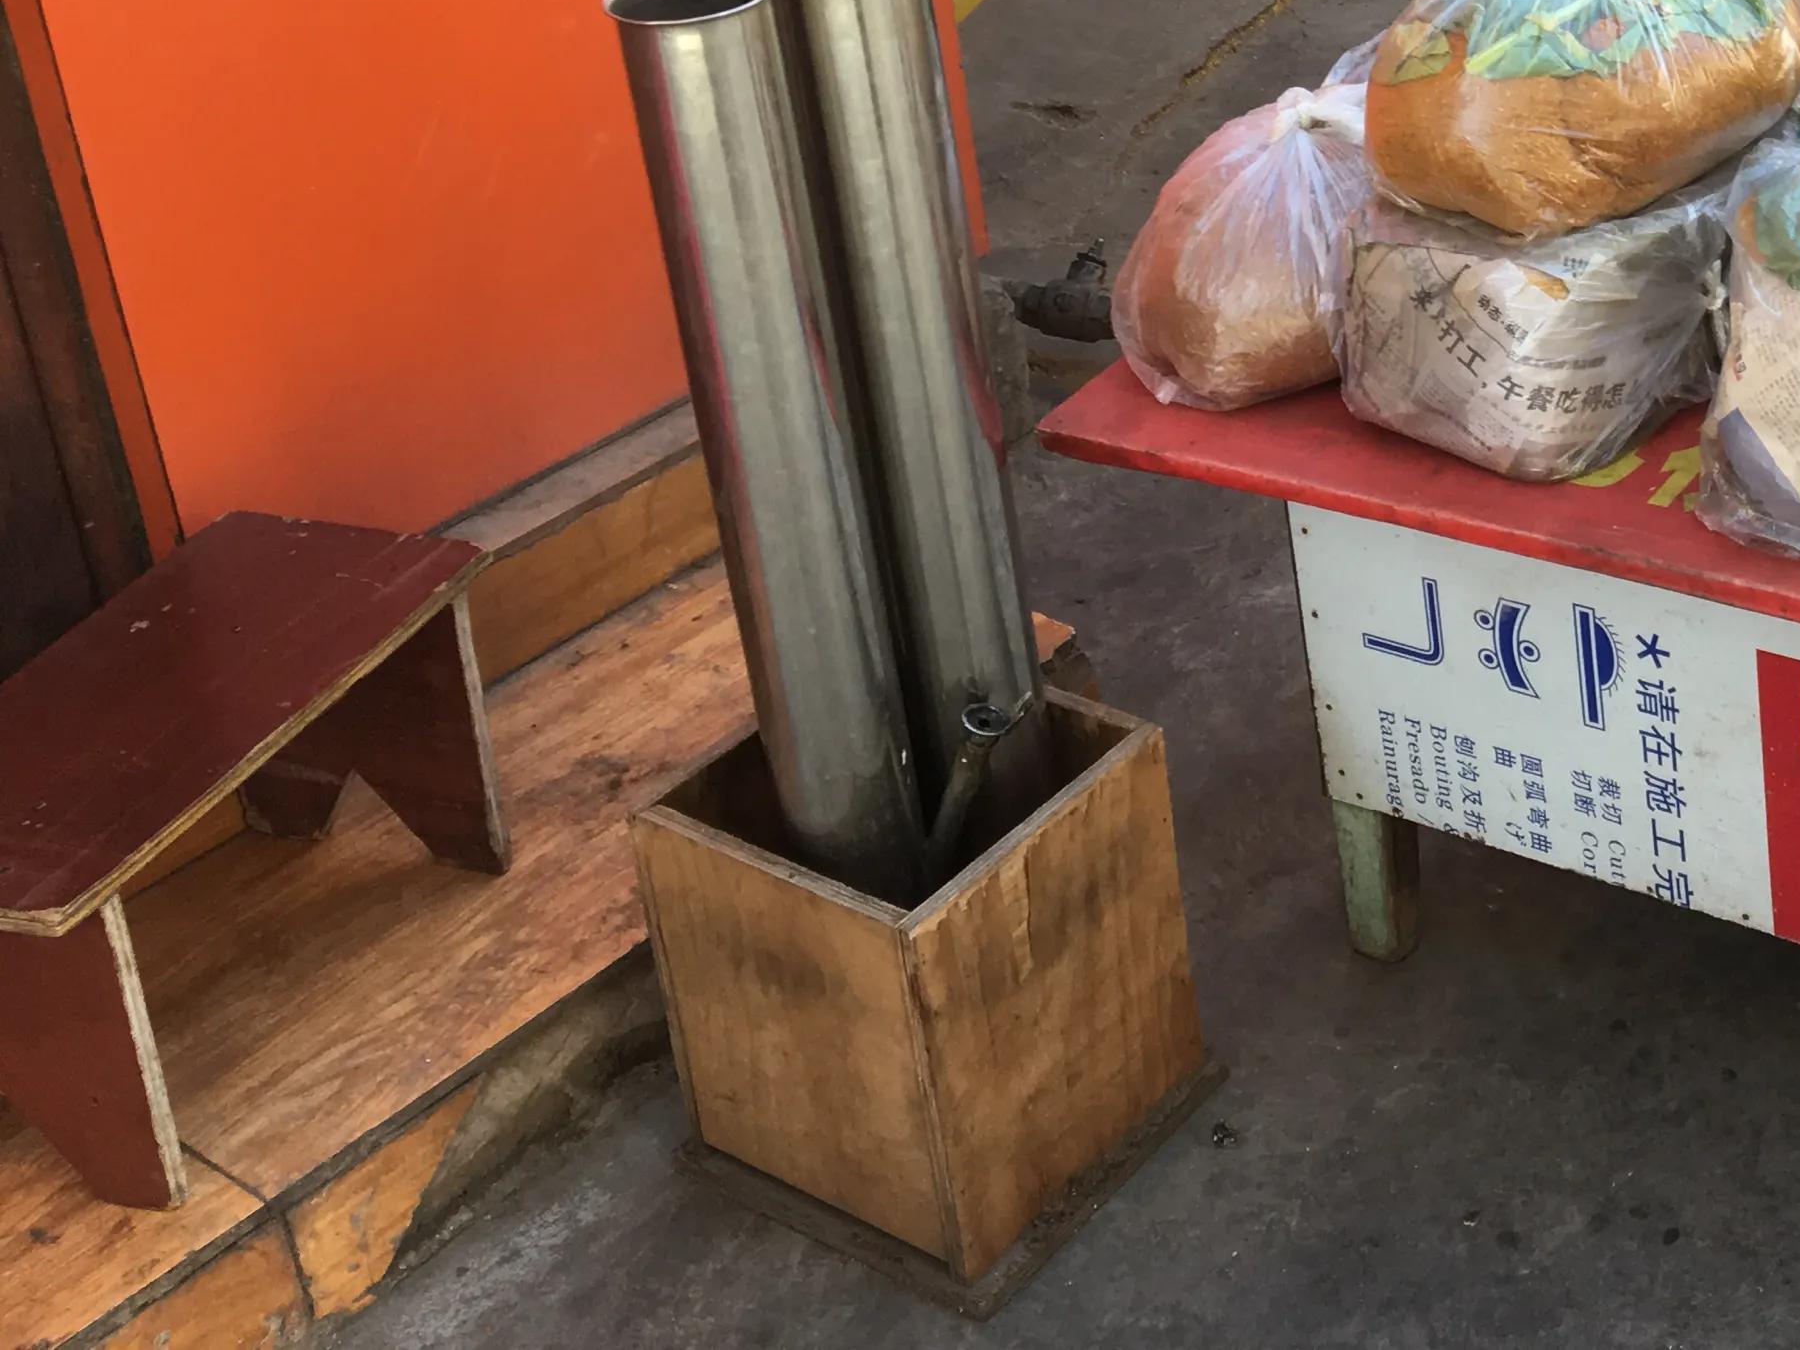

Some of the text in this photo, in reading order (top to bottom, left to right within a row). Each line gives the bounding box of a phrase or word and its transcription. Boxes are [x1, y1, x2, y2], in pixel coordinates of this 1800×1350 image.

[1404, 713, 1430, 805] Fresado
[1570, 770, 1599, 878] 切断 Cor
